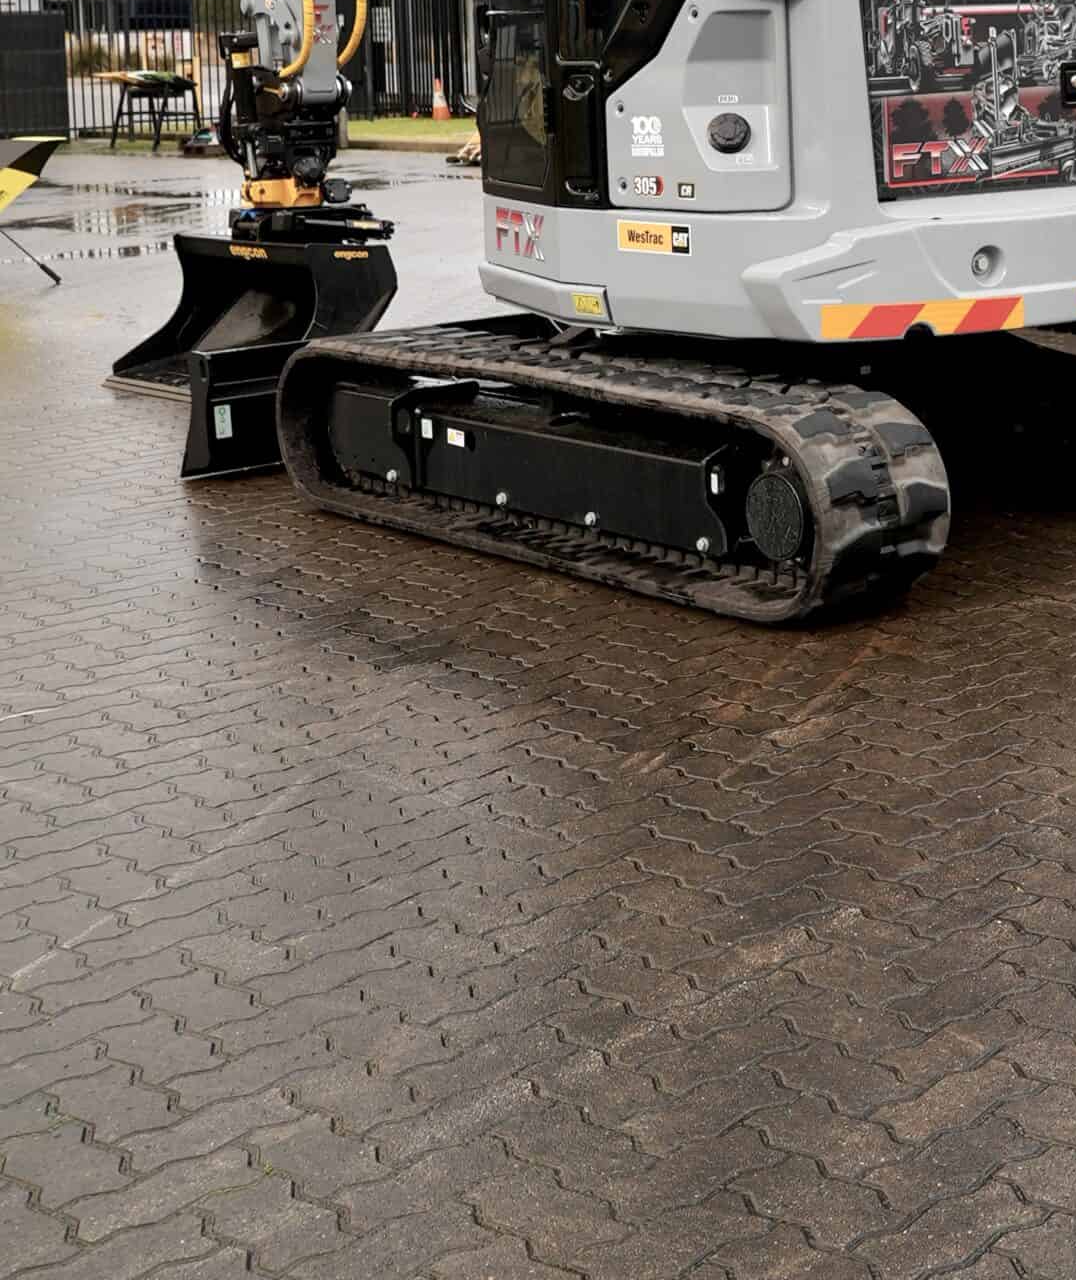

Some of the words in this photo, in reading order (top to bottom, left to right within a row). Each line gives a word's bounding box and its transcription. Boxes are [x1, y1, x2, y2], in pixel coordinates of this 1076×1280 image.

[630, 116, 662, 135] 100
[632, 135, 662, 144] YEARS
[893, 137, 989, 177] FTX
[634, 176, 657, 195] 305
[496, 206, 545, 261] FTX
[627, 229, 664, 245] WesTrac
[672, 232, 688, 247] CAT
[333, 250, 369, 261] engcon
